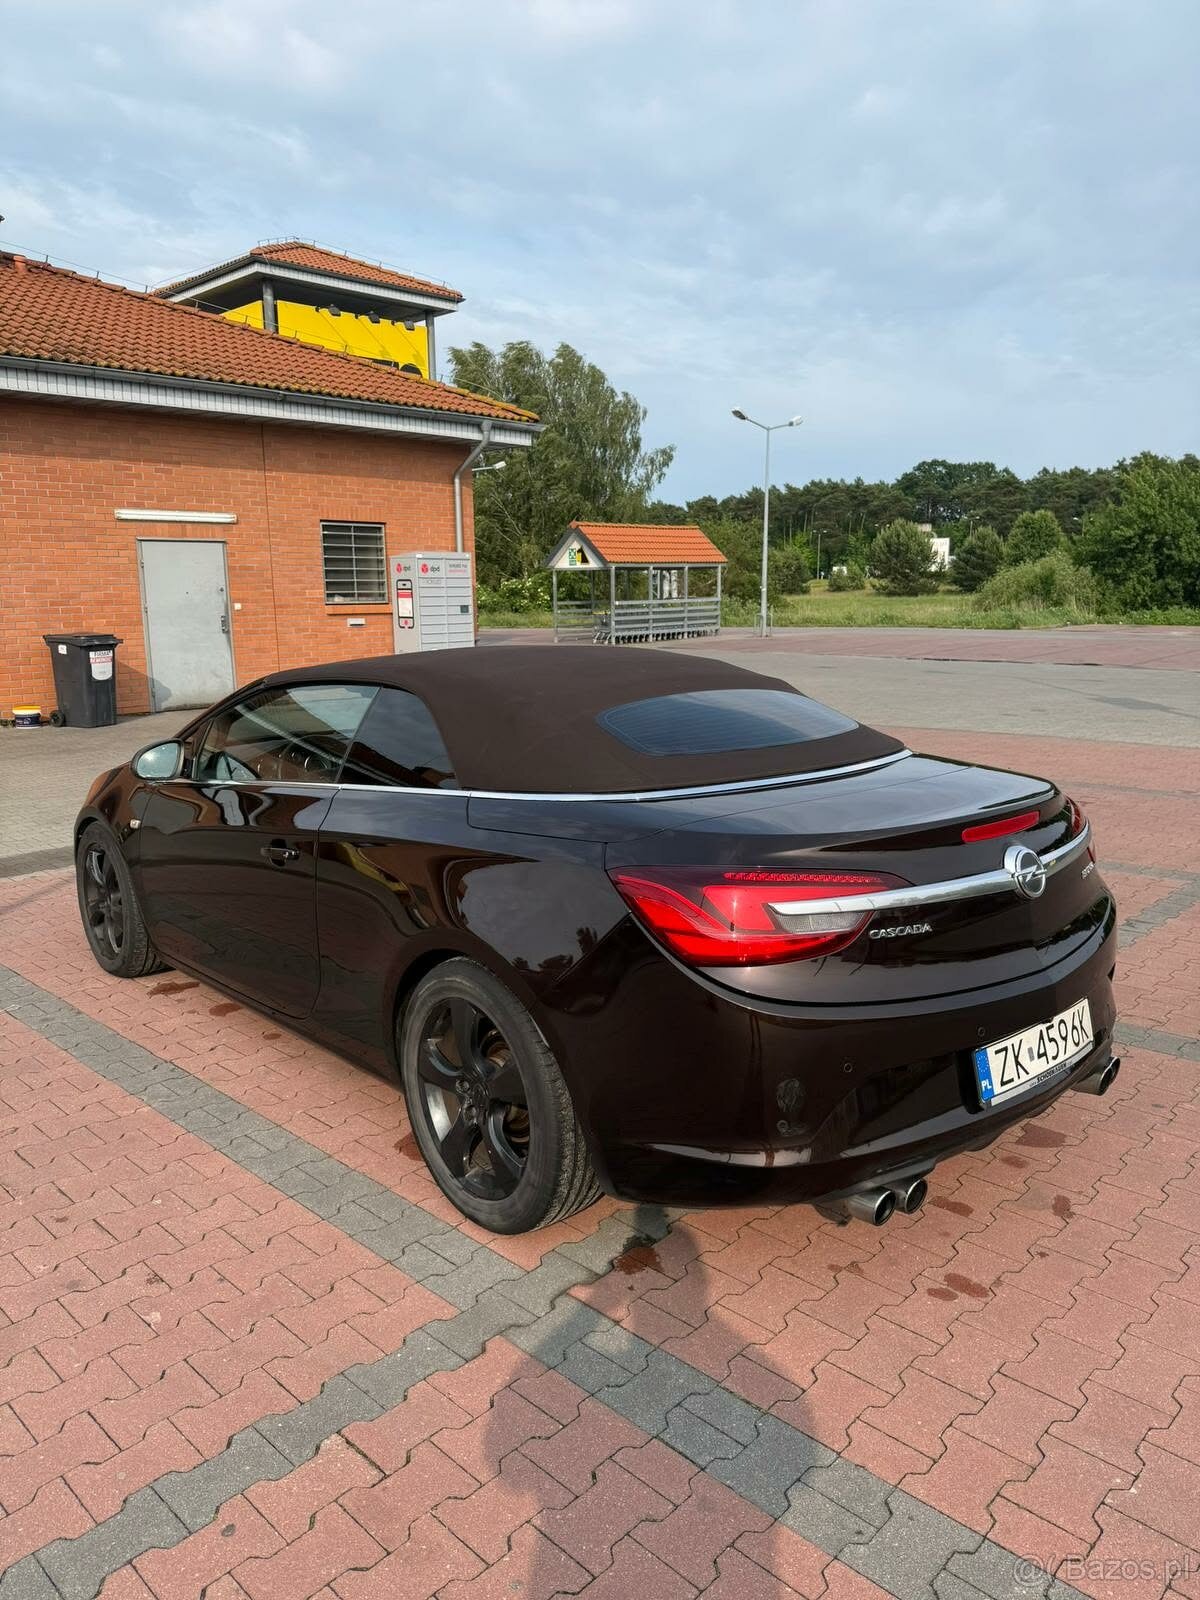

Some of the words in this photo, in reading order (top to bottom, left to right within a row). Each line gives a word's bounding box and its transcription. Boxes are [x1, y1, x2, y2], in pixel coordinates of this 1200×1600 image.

[869, 923, 933, 939] CASCADA
[994, 1039, 1030, 1087] ZK
[1037, 1006, 1090, 1065] 4596K
[981, 1081, 992, 1092] PL
